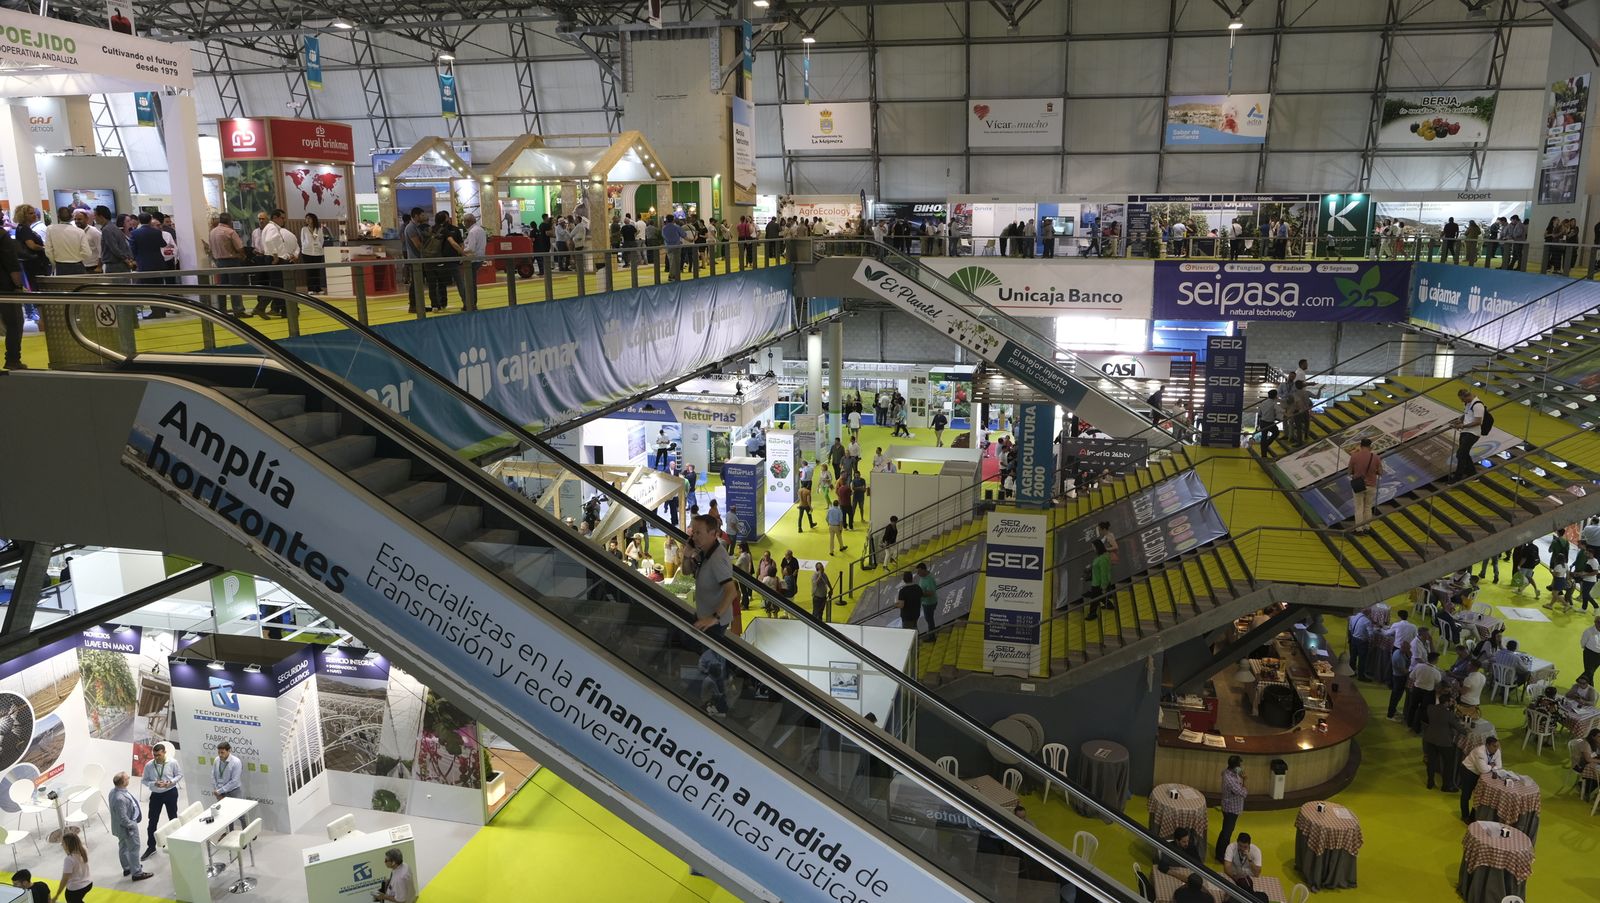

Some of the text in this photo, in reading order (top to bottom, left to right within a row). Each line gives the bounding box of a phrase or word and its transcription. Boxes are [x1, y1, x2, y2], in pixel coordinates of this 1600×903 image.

[42, 52, 78, 65] ANDALUZA
[102, 45, 177, 67] Cultivando el futuro
[136, 62, 178, 76] desde 1979
[1423, 97, 1461, 107] BERJA,
[986, 119, 1012, 129] Vícar
[1017, 120, 1048, 129] mucho
[302, 137, 349, 151] royal brinkman
[799, 207, 851, 218] AgroEcology
[880, 278, 942, 318] El Plantel
[998, 286, 1123, 306] Unicaja Banco
[1429, 283, 1461, 307] cajamar
[1230, 308, 1297, 318] natural technology
[1210, 339, 1243, 349] SER
[497, 341, 578, 391] cajamar
[1013, 349, 1068, 387] El mejor injerto
[1101, 363, 1136, 377] CASI
[1007, 357, 1065, 395] para tu cosecha
[1208, 376, 1241, 387] SER
[1206, 413, 1238, 424] SER
[159, 400, 297, 510] Amplía
[1021, 405, 1037, 497] AGRICULTURA
[1033, 466, 1046, 498] 2000
[146, 434, 350, 595] horizontes
[1000, 519, 1021, 527] SER
[992, 524, 1037, 538] Agricultor
[988, 551, 1040, 570] SER
[998, 584, 1018, 592] SER
[990, 589, 1034, 603] Agricultor
[84, 639, 135, 652] LLAVE EN MANO
[995, 645, 1016, 653] SER
[988, 649, 1031, 662] Agricultor
[277, 659, 308, 684] SEGURIDAD
[195, 708, 259, 721] TECNOPONIENTE
[366, 566, 494, 667] transmisión
[492, 662, 514, 678] y
[513, 672, 663, 780] reconversión
[668, 773, 700, 803] de
[701, 791, 774, 852] fincas
[376, 542, 889, 897] Especialistas en la financiación a medida de
[214, 725, 242, 735] DISEÑO
[206, 733, 253, 747] FABRICACIÓN
